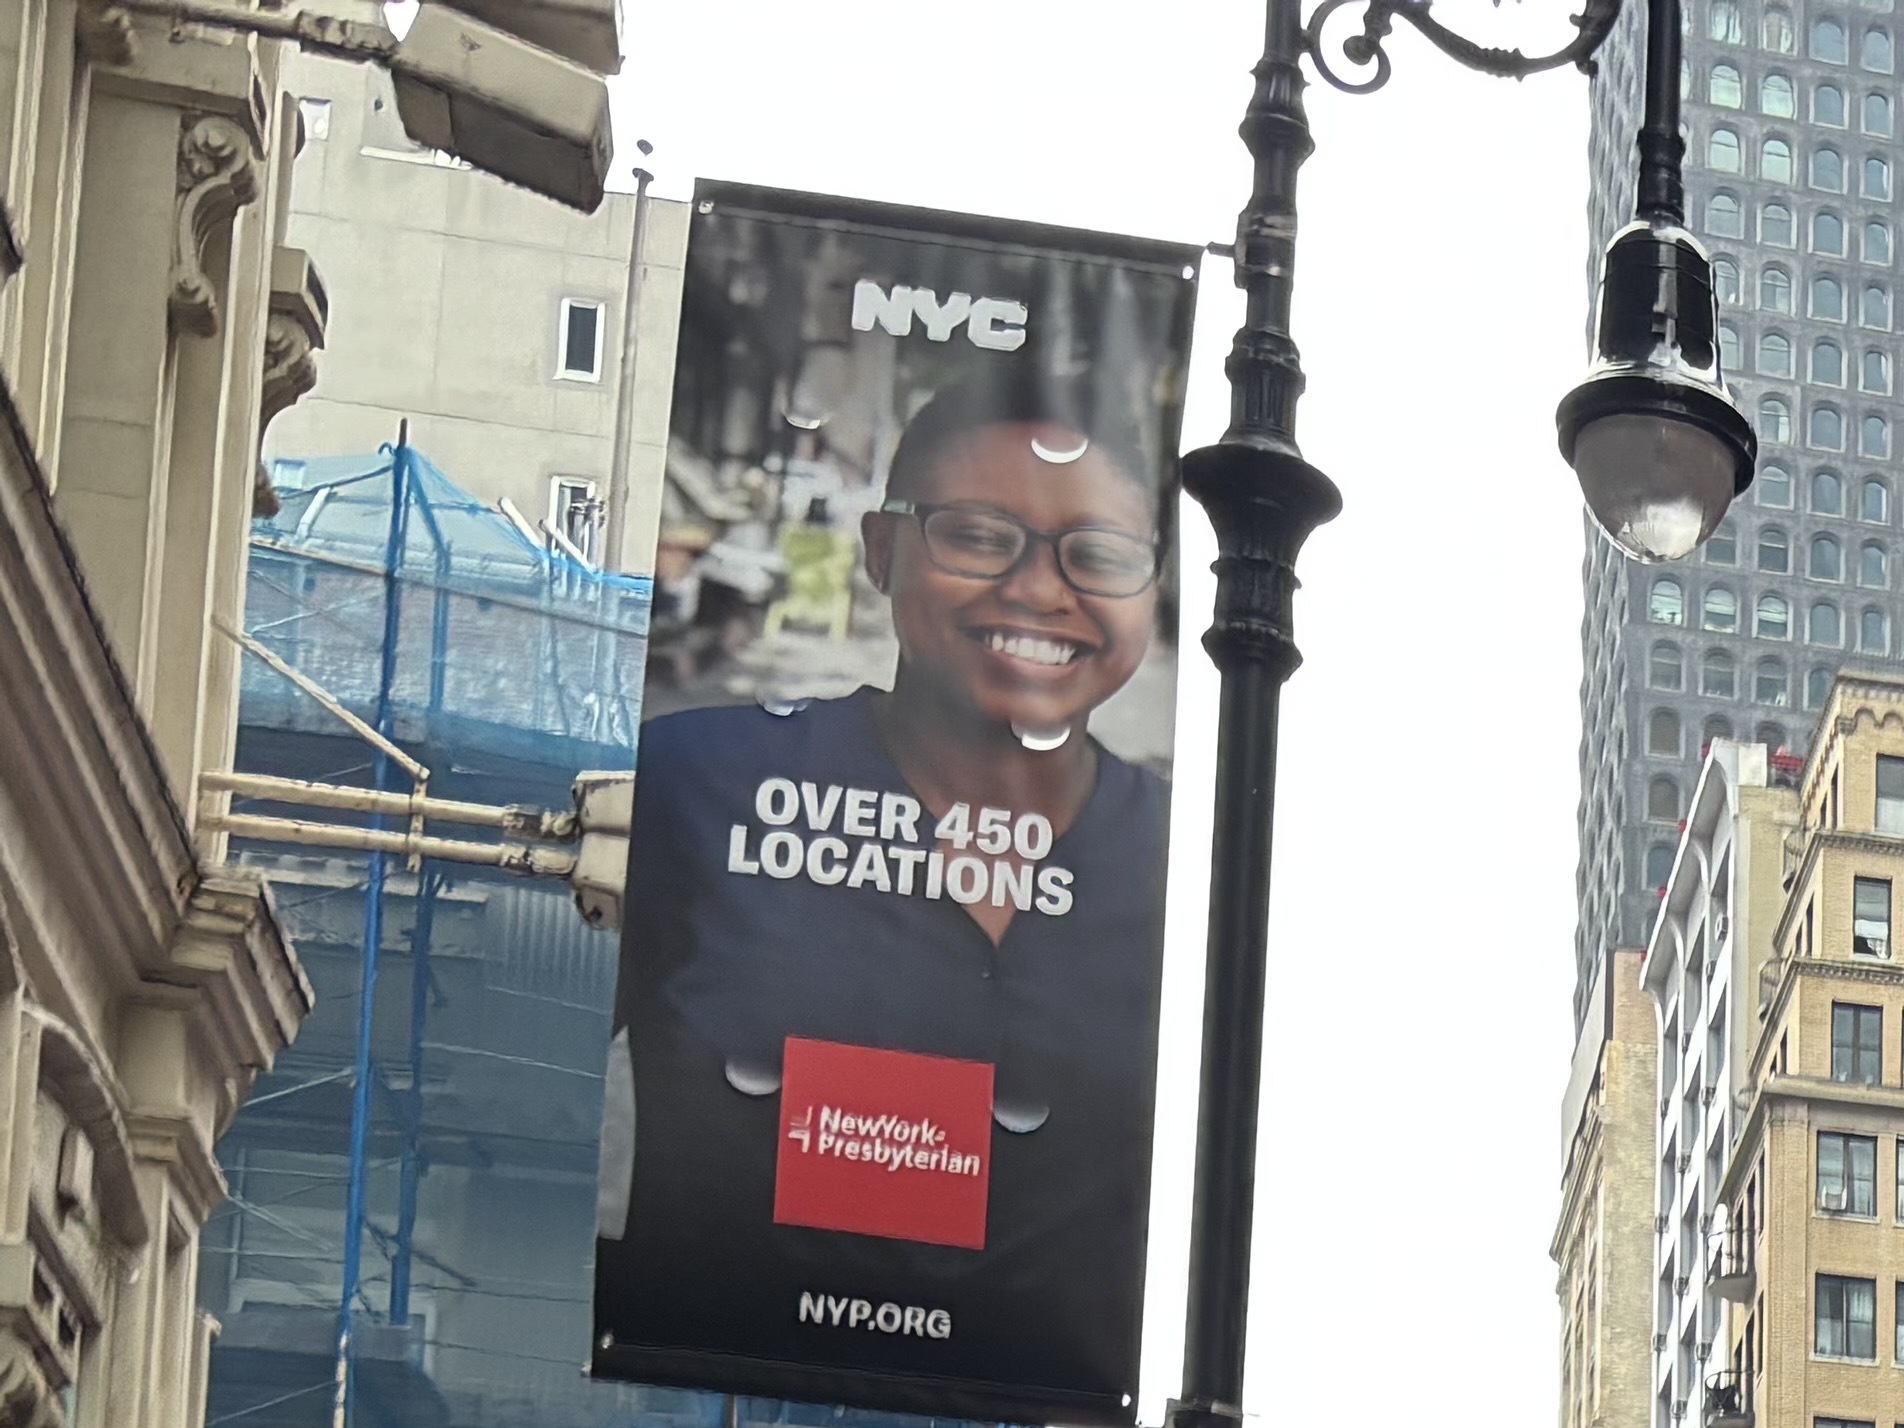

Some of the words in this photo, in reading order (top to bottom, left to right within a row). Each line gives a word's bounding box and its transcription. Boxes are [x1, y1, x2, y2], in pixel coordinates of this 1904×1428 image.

[852, 279, 1028, 351] NYC
[756, 777, 921, 843] OVER
[934, 802, 1053, 860] 450
[728, 824, 1075, 916] LOCATIONS
[818, 1131, 980, 1176] Presbyterian
[799, 1291, 951, 1339] NYP.ORG
